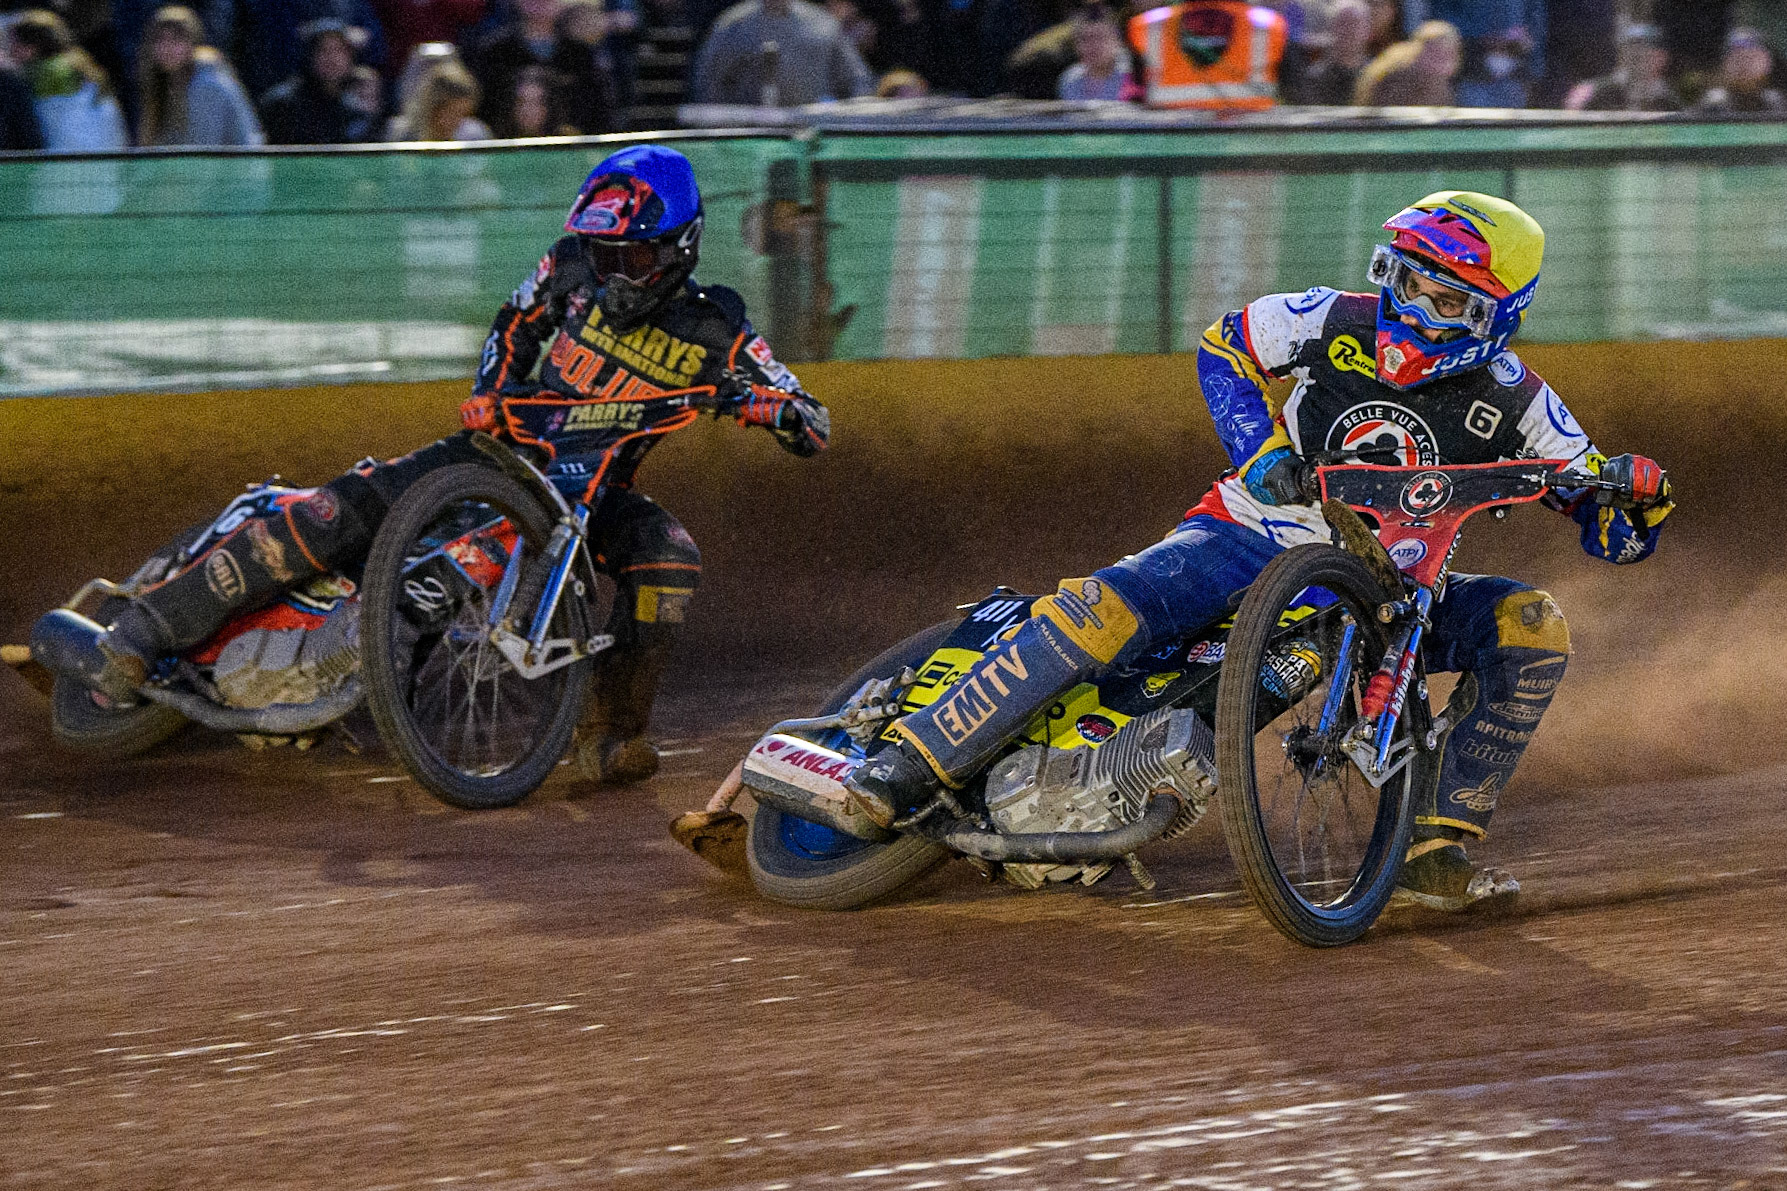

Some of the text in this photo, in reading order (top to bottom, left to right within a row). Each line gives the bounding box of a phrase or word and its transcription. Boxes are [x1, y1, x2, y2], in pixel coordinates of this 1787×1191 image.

[1506, 282, 1539, 313] JUS
[1495, 356, 1518, 378] ATPI
[567, 403, 646, 424] PARRYS
[1464, 400, 1503, 440] 6
[1342, 408, 1433, 466] BELLE VUE ACES
[1393, 548, 1420, 557] ATPI
